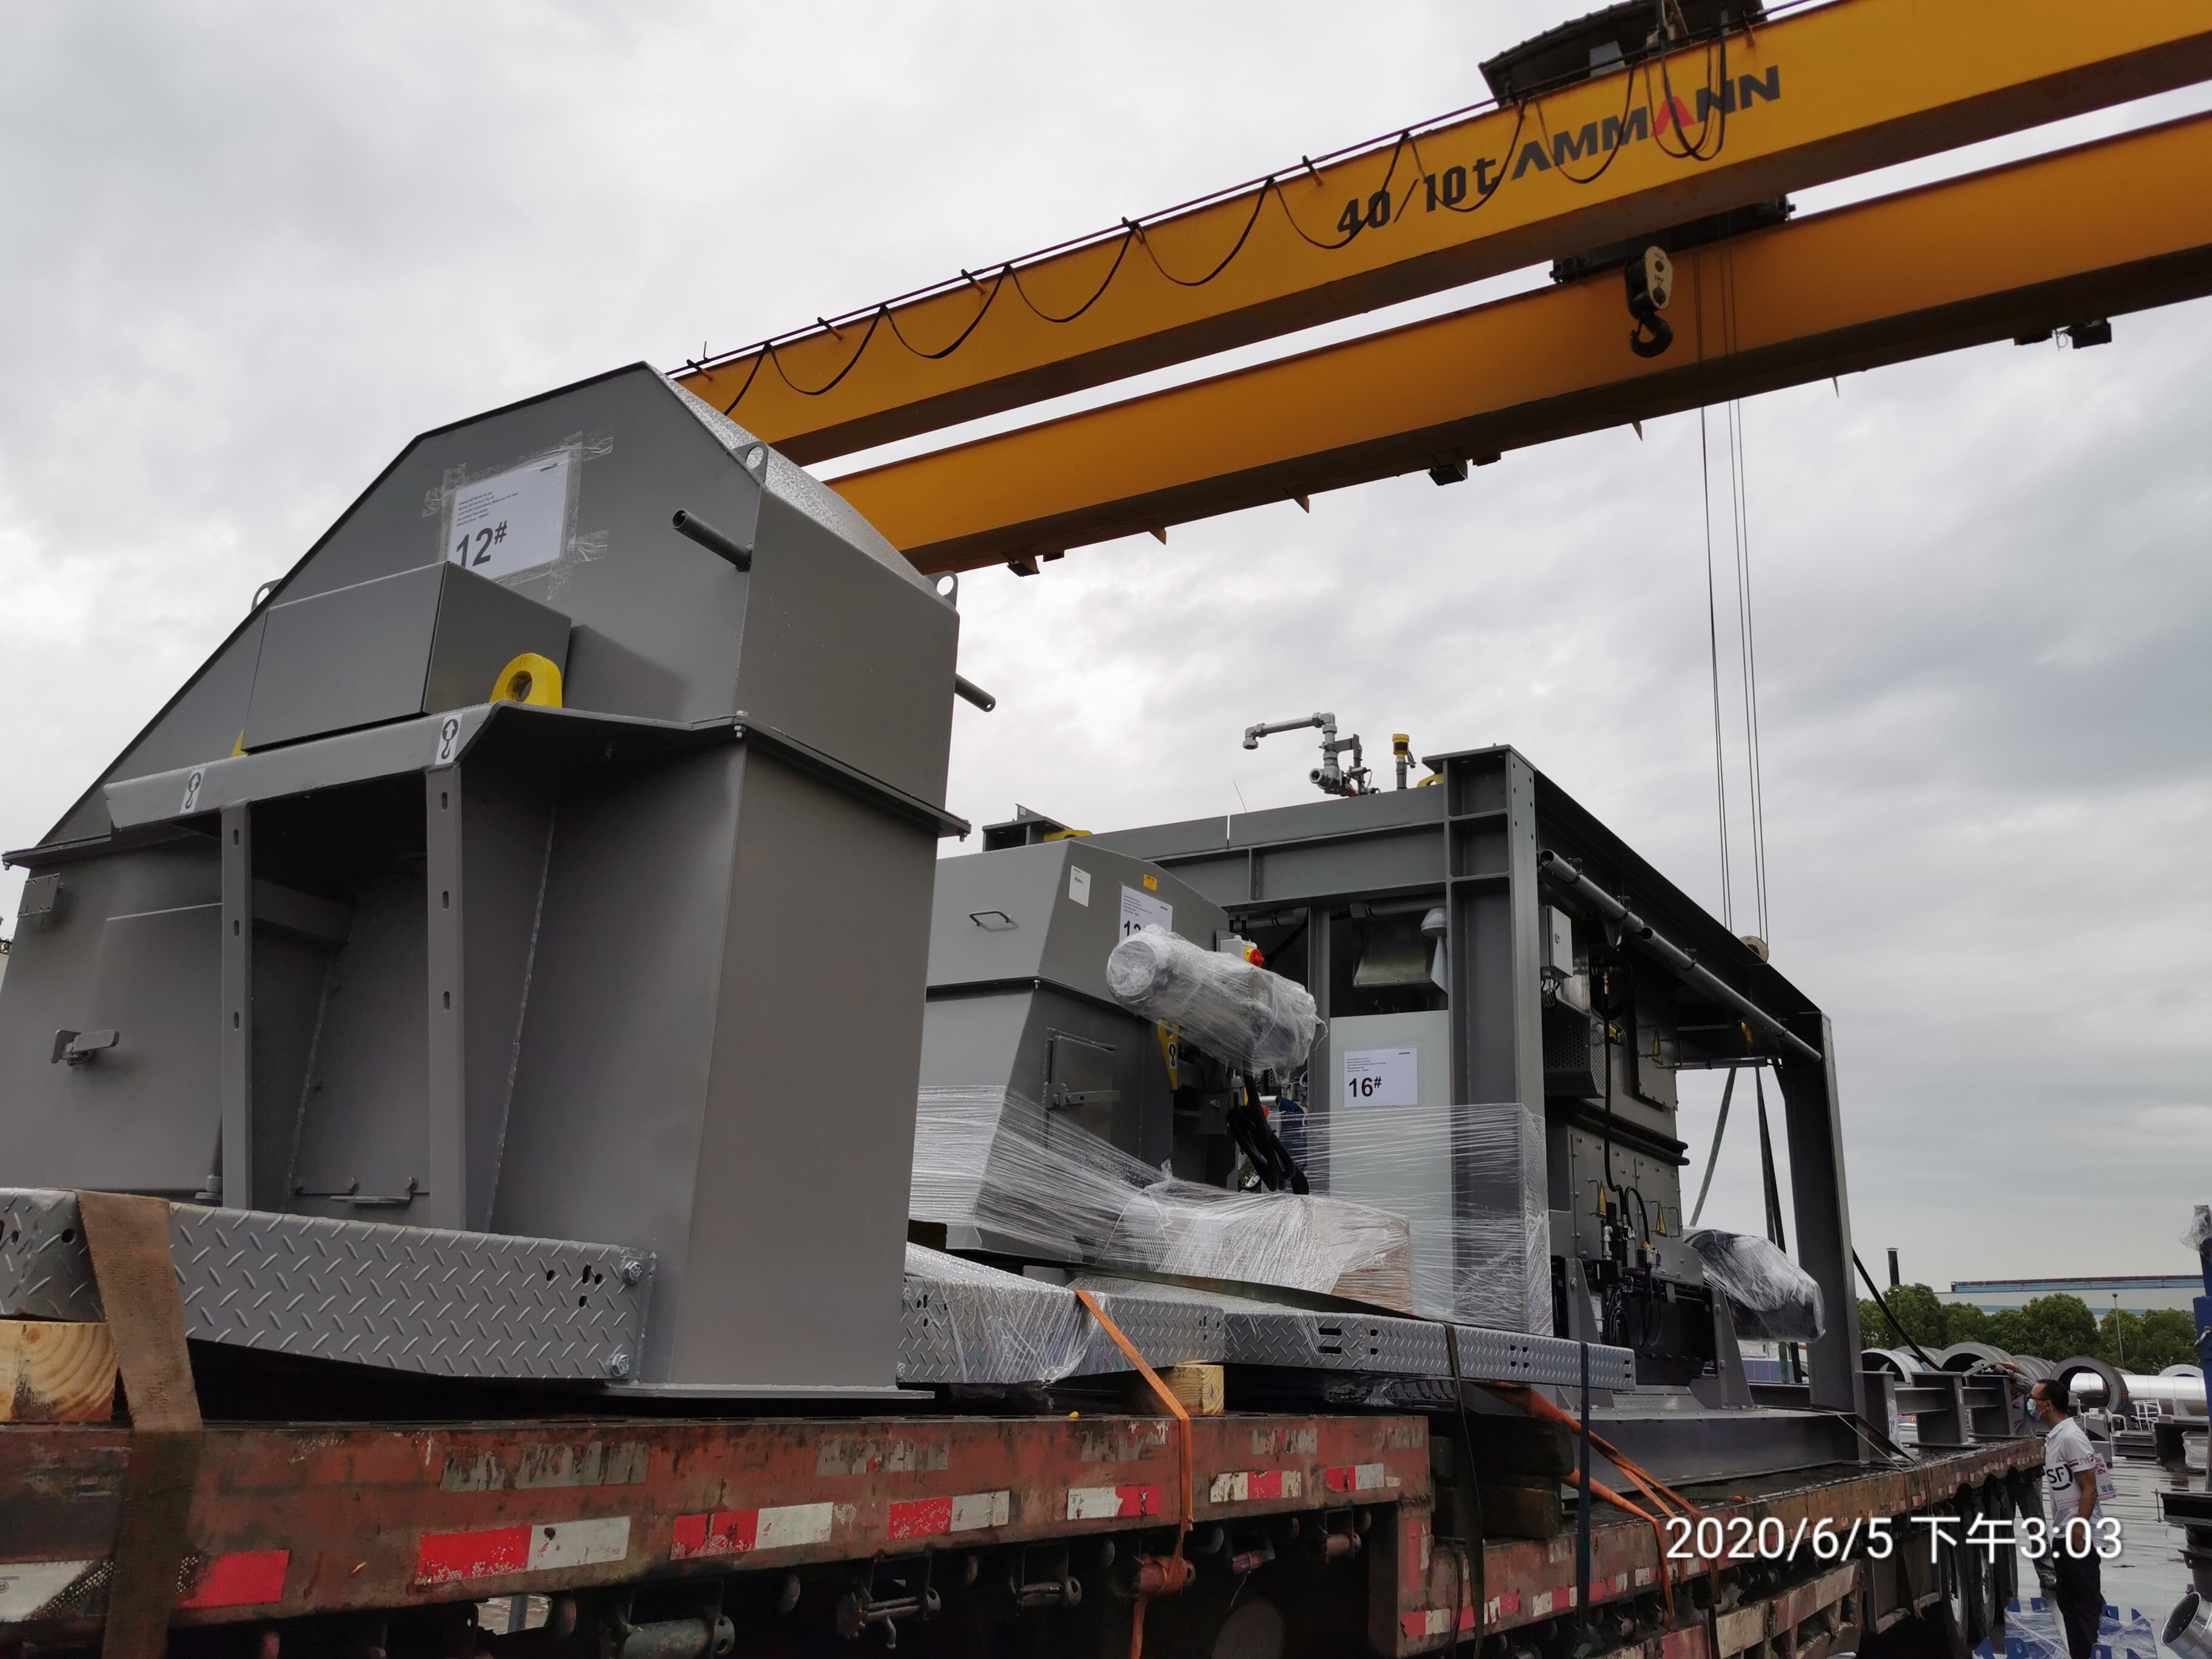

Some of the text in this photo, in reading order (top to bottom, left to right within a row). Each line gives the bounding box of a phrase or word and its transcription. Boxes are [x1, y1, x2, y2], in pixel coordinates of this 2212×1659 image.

[1336, 65, 1781, 234] 40/10t AMMANN
[456, 520, 507, 568] 12#
[1349, 1076, 1382, 1098] 16#
